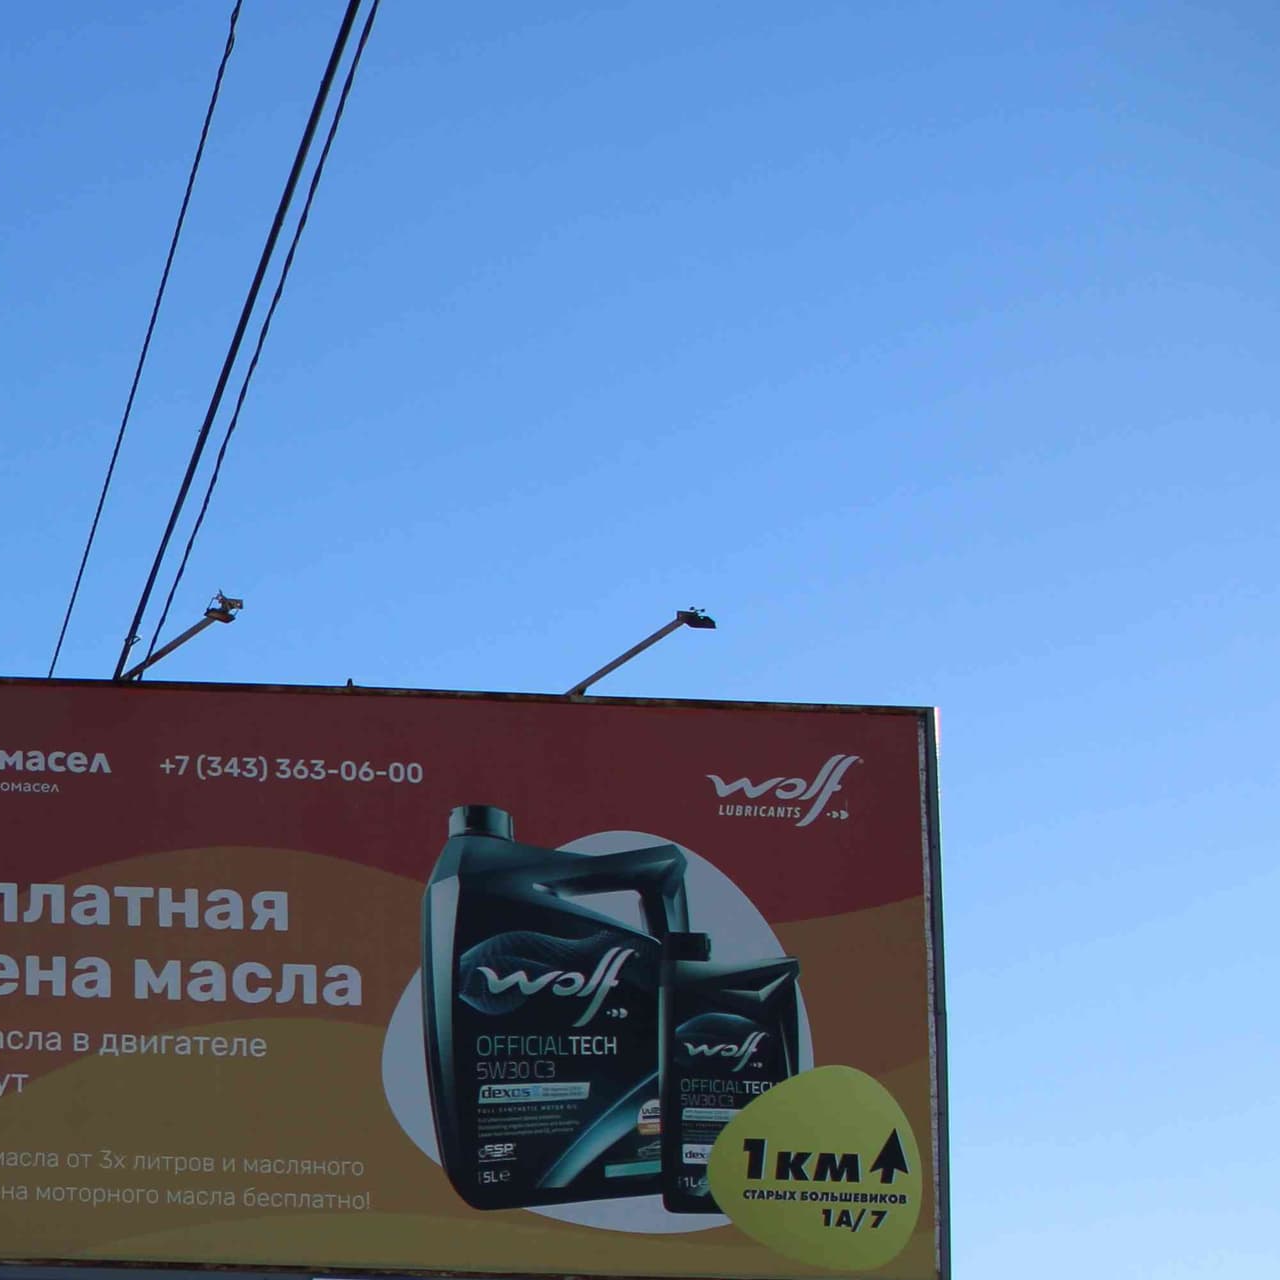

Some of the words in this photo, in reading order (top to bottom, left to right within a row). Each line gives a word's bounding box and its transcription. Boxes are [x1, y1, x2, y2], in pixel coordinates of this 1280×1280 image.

[160, 756, 189, 775] +7
[197, 755, 267, 782] (343)
[276, 759, 422, 783] 363-06-00
[718, 803, 802, 819] LUBRICANTS
[135, 959, 361, 1005] масла
[74, 1033, 89, 1051] в
[99, 1034, 266, 1057] двигателе
[477, 1061, 529, 1079] 5W30
[534, 1060, 555, 1078] C3
[680, 1079, 778, 1094] OFFICIALTEC
[67, 1153, 92, 1168] от
[100, 1150, 126, 1168] 3х
[133, 1156, 214, 1175] литров
[223, 1158, 235, 1172] и
[244, 1159, 364, 1176] масляного
[743, 1138, 767, 1180] 1
[776, 1151, 861, 1183] км
[37, 1186, 158, 1206] моторного
[168, 1190, 235, 1206] масла
[244, 1187, 370, 1209] бесплатно!
[743, 1189, 797, 1202] СТАРЫХ
[800, 1192, 906, 1204] БОЛЬШЕВИКОВ
